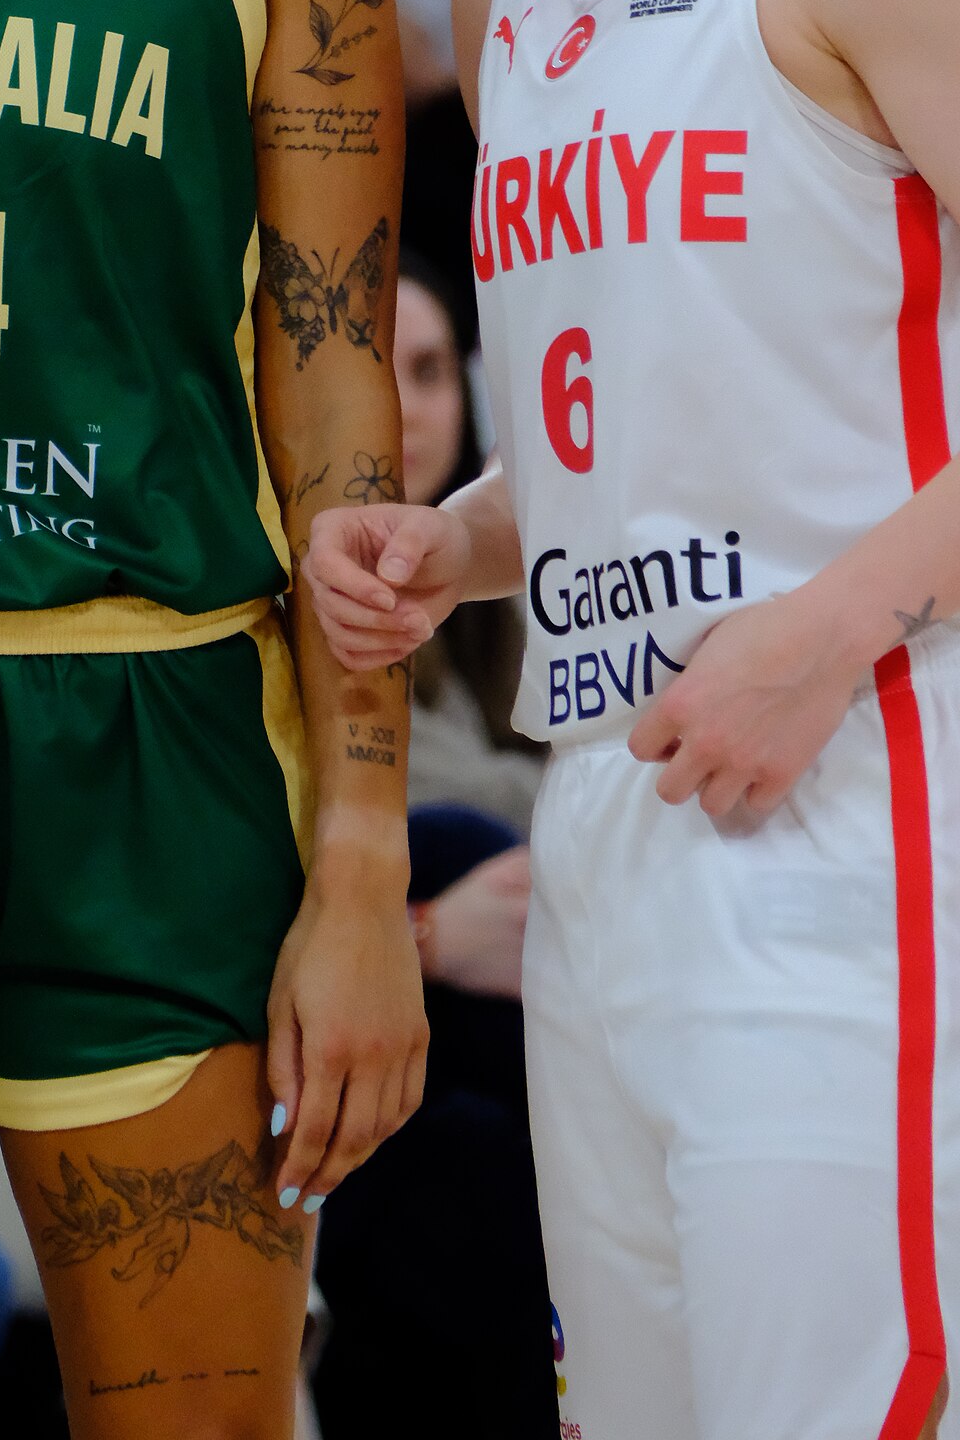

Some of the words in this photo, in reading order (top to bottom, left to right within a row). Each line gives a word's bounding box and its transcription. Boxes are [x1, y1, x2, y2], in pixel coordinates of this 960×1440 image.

[630, 0, 657, 10] WORLD
[471, 109, 748, 282] ÜRKİYE
[540, 327, 594, 474] 6
[530, 530, 743, 636] Garanti
[549, 630, 686, 726] BBVA
